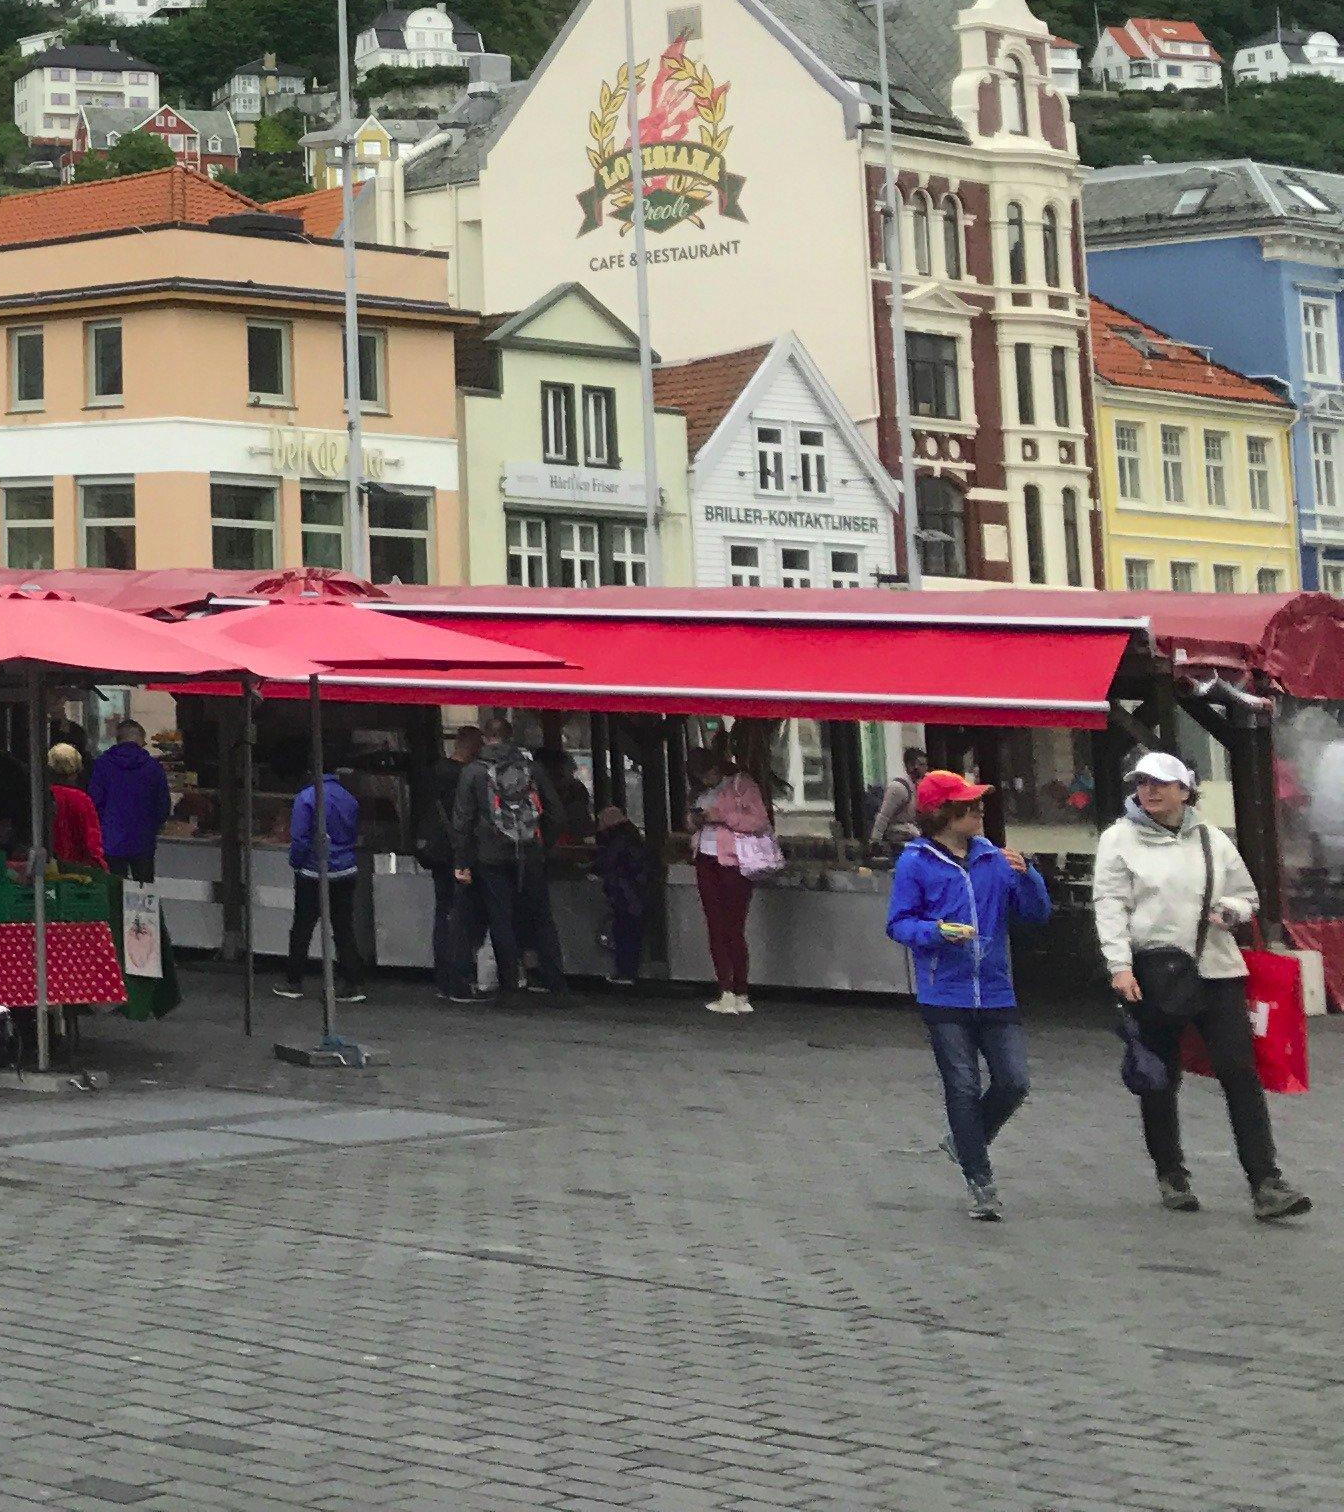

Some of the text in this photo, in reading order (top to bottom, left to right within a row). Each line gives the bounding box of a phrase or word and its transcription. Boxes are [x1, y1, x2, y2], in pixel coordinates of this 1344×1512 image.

[598, 145, 720, 190] LOISIANA
[589, 250, 626, 272] CAFÉ
[646, 240, 741, 265] RESTAURANT
[704, 505, 879, 533] BRILLER-KONTAKTLINSER
